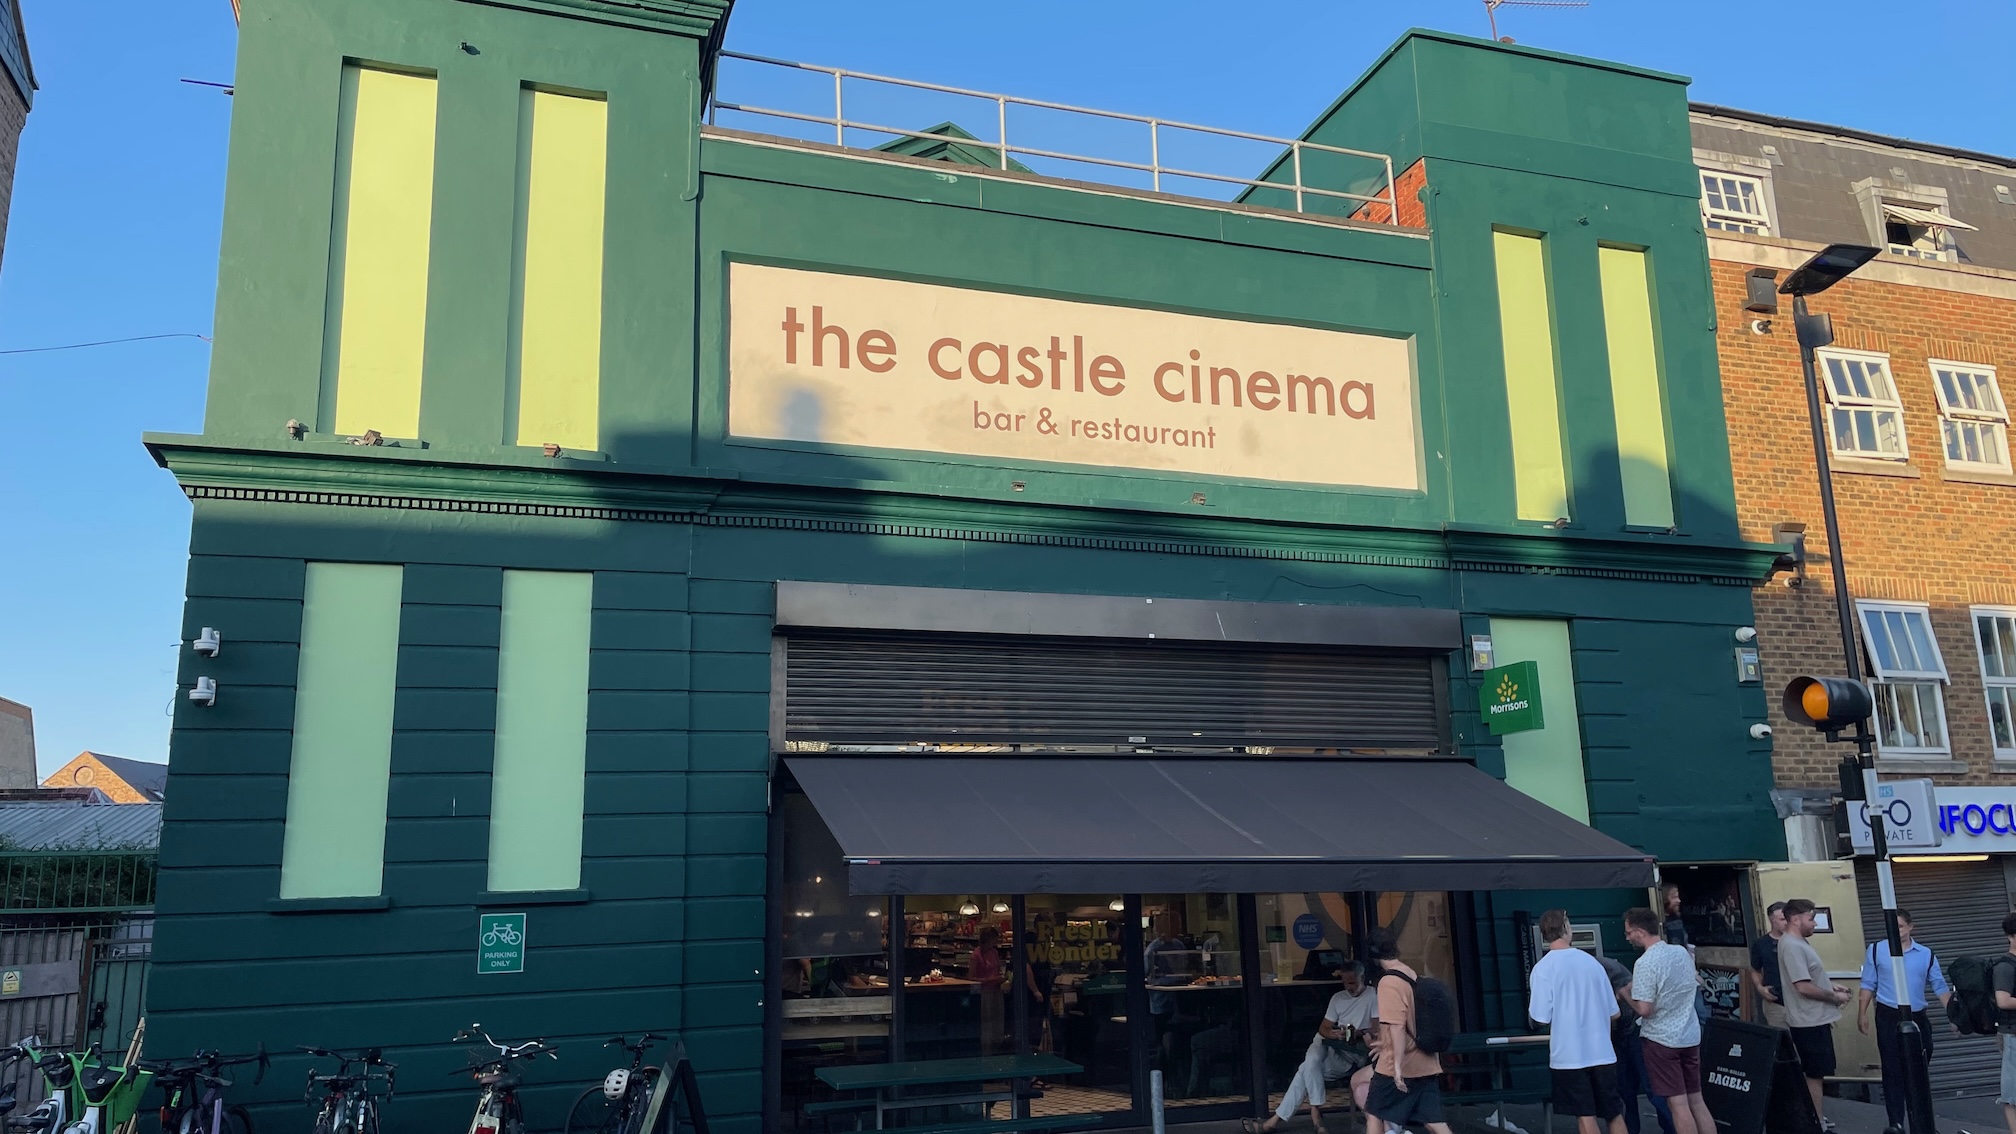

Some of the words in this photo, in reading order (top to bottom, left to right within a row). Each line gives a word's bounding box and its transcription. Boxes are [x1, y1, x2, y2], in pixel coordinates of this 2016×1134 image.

[782, 305, 897, 373] the
[928, 334, 1126, 397] castle
[1153, 349, 1376, 420] cinema
[973, 401, 1026, 431] bar
[1036, 408, 1060, 436] &
[1071, 416, 1216, 449] restaurant
[1490, 700, 1528, 714] Morrisons
[1864, 829, 1913, 842] PVATE
[1037, 919, 1108, 942] Fresh
[1298, 924, 1318, 933] NHS
[484, 951, 517, 959] PARKING
[1026, 940, 1121, 965] Wonder
[490, 960, 511, 968] ONLY
[1708, 1071, 1752, 1092] BAGELS
